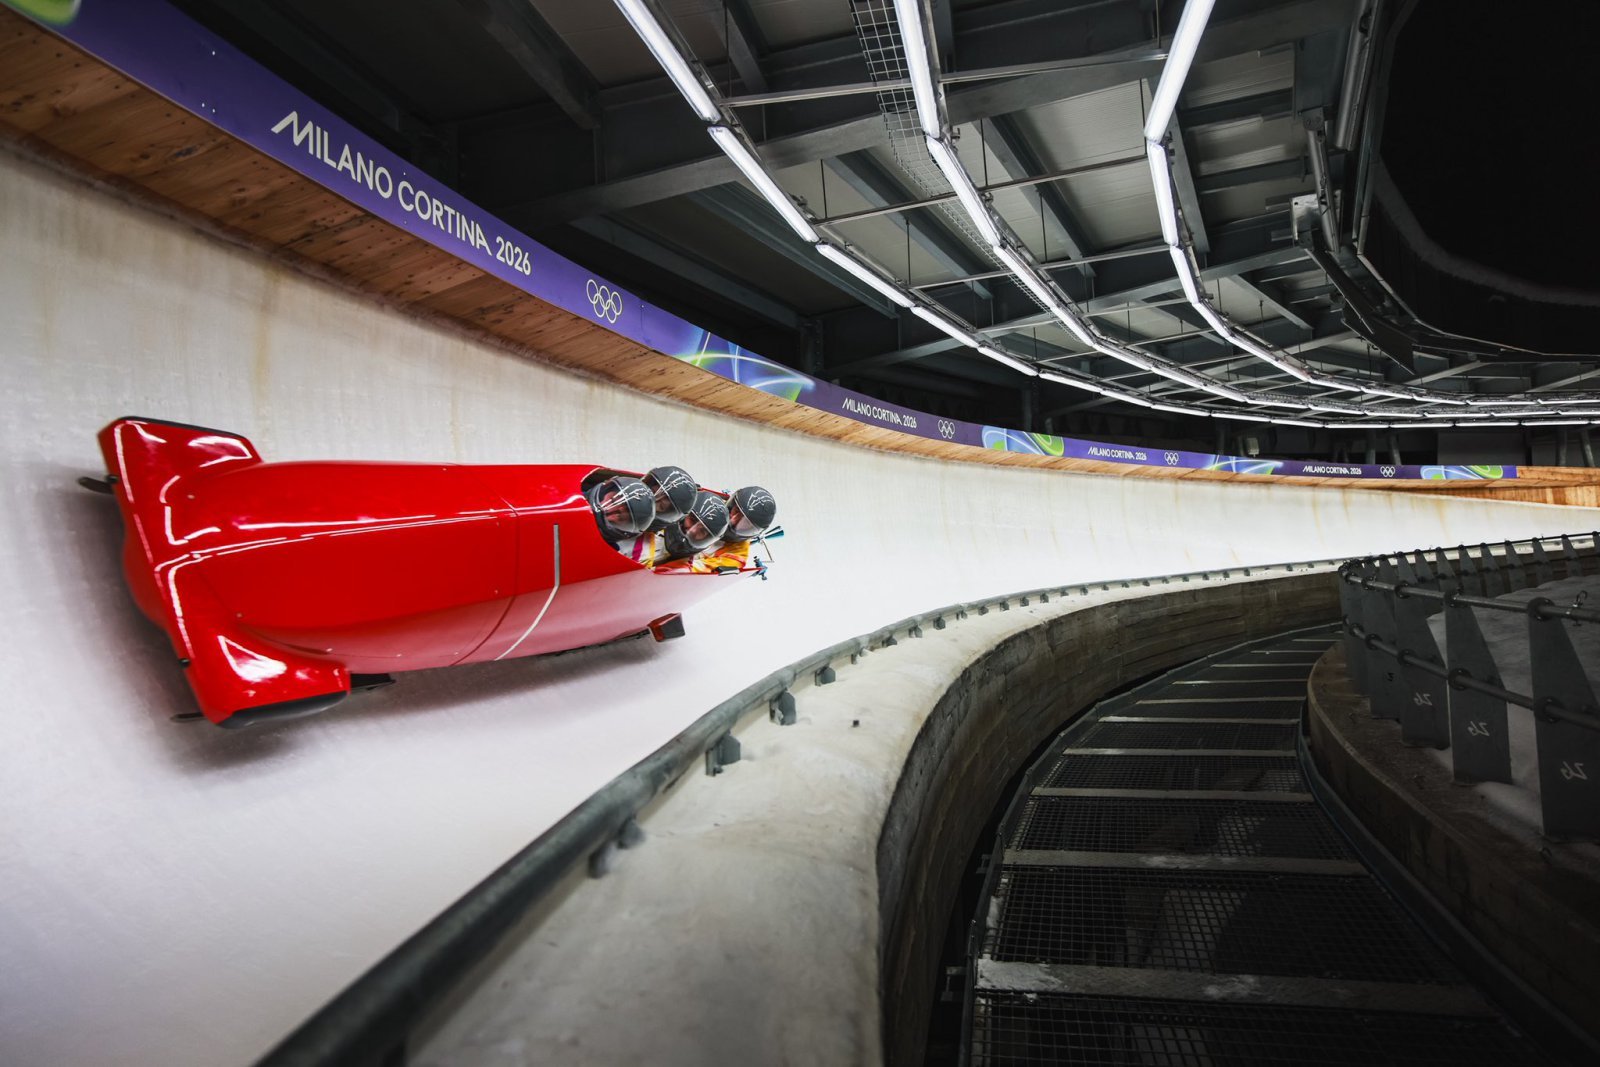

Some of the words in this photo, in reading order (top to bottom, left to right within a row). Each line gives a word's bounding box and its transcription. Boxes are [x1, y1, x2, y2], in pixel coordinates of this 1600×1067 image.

[271, 111, 393, 199] MILANO
[397, 181, 492, 256] CORTINA
[495, 236, 532, 276] 2026
[842, 398, 872, 416] MILANO
[872, 407, 902, 426] CORTINA
[903, 415, 917, 429] 2026
[1088, 446, 1110, 457] MILANO
[1111, 450, 1135, 460] CORTINA
[1135, 452, 1147, 461] 2026
[1303, 465, 1325, 474] MILANO
[1326, 466, 1350, 475] CORTINA
